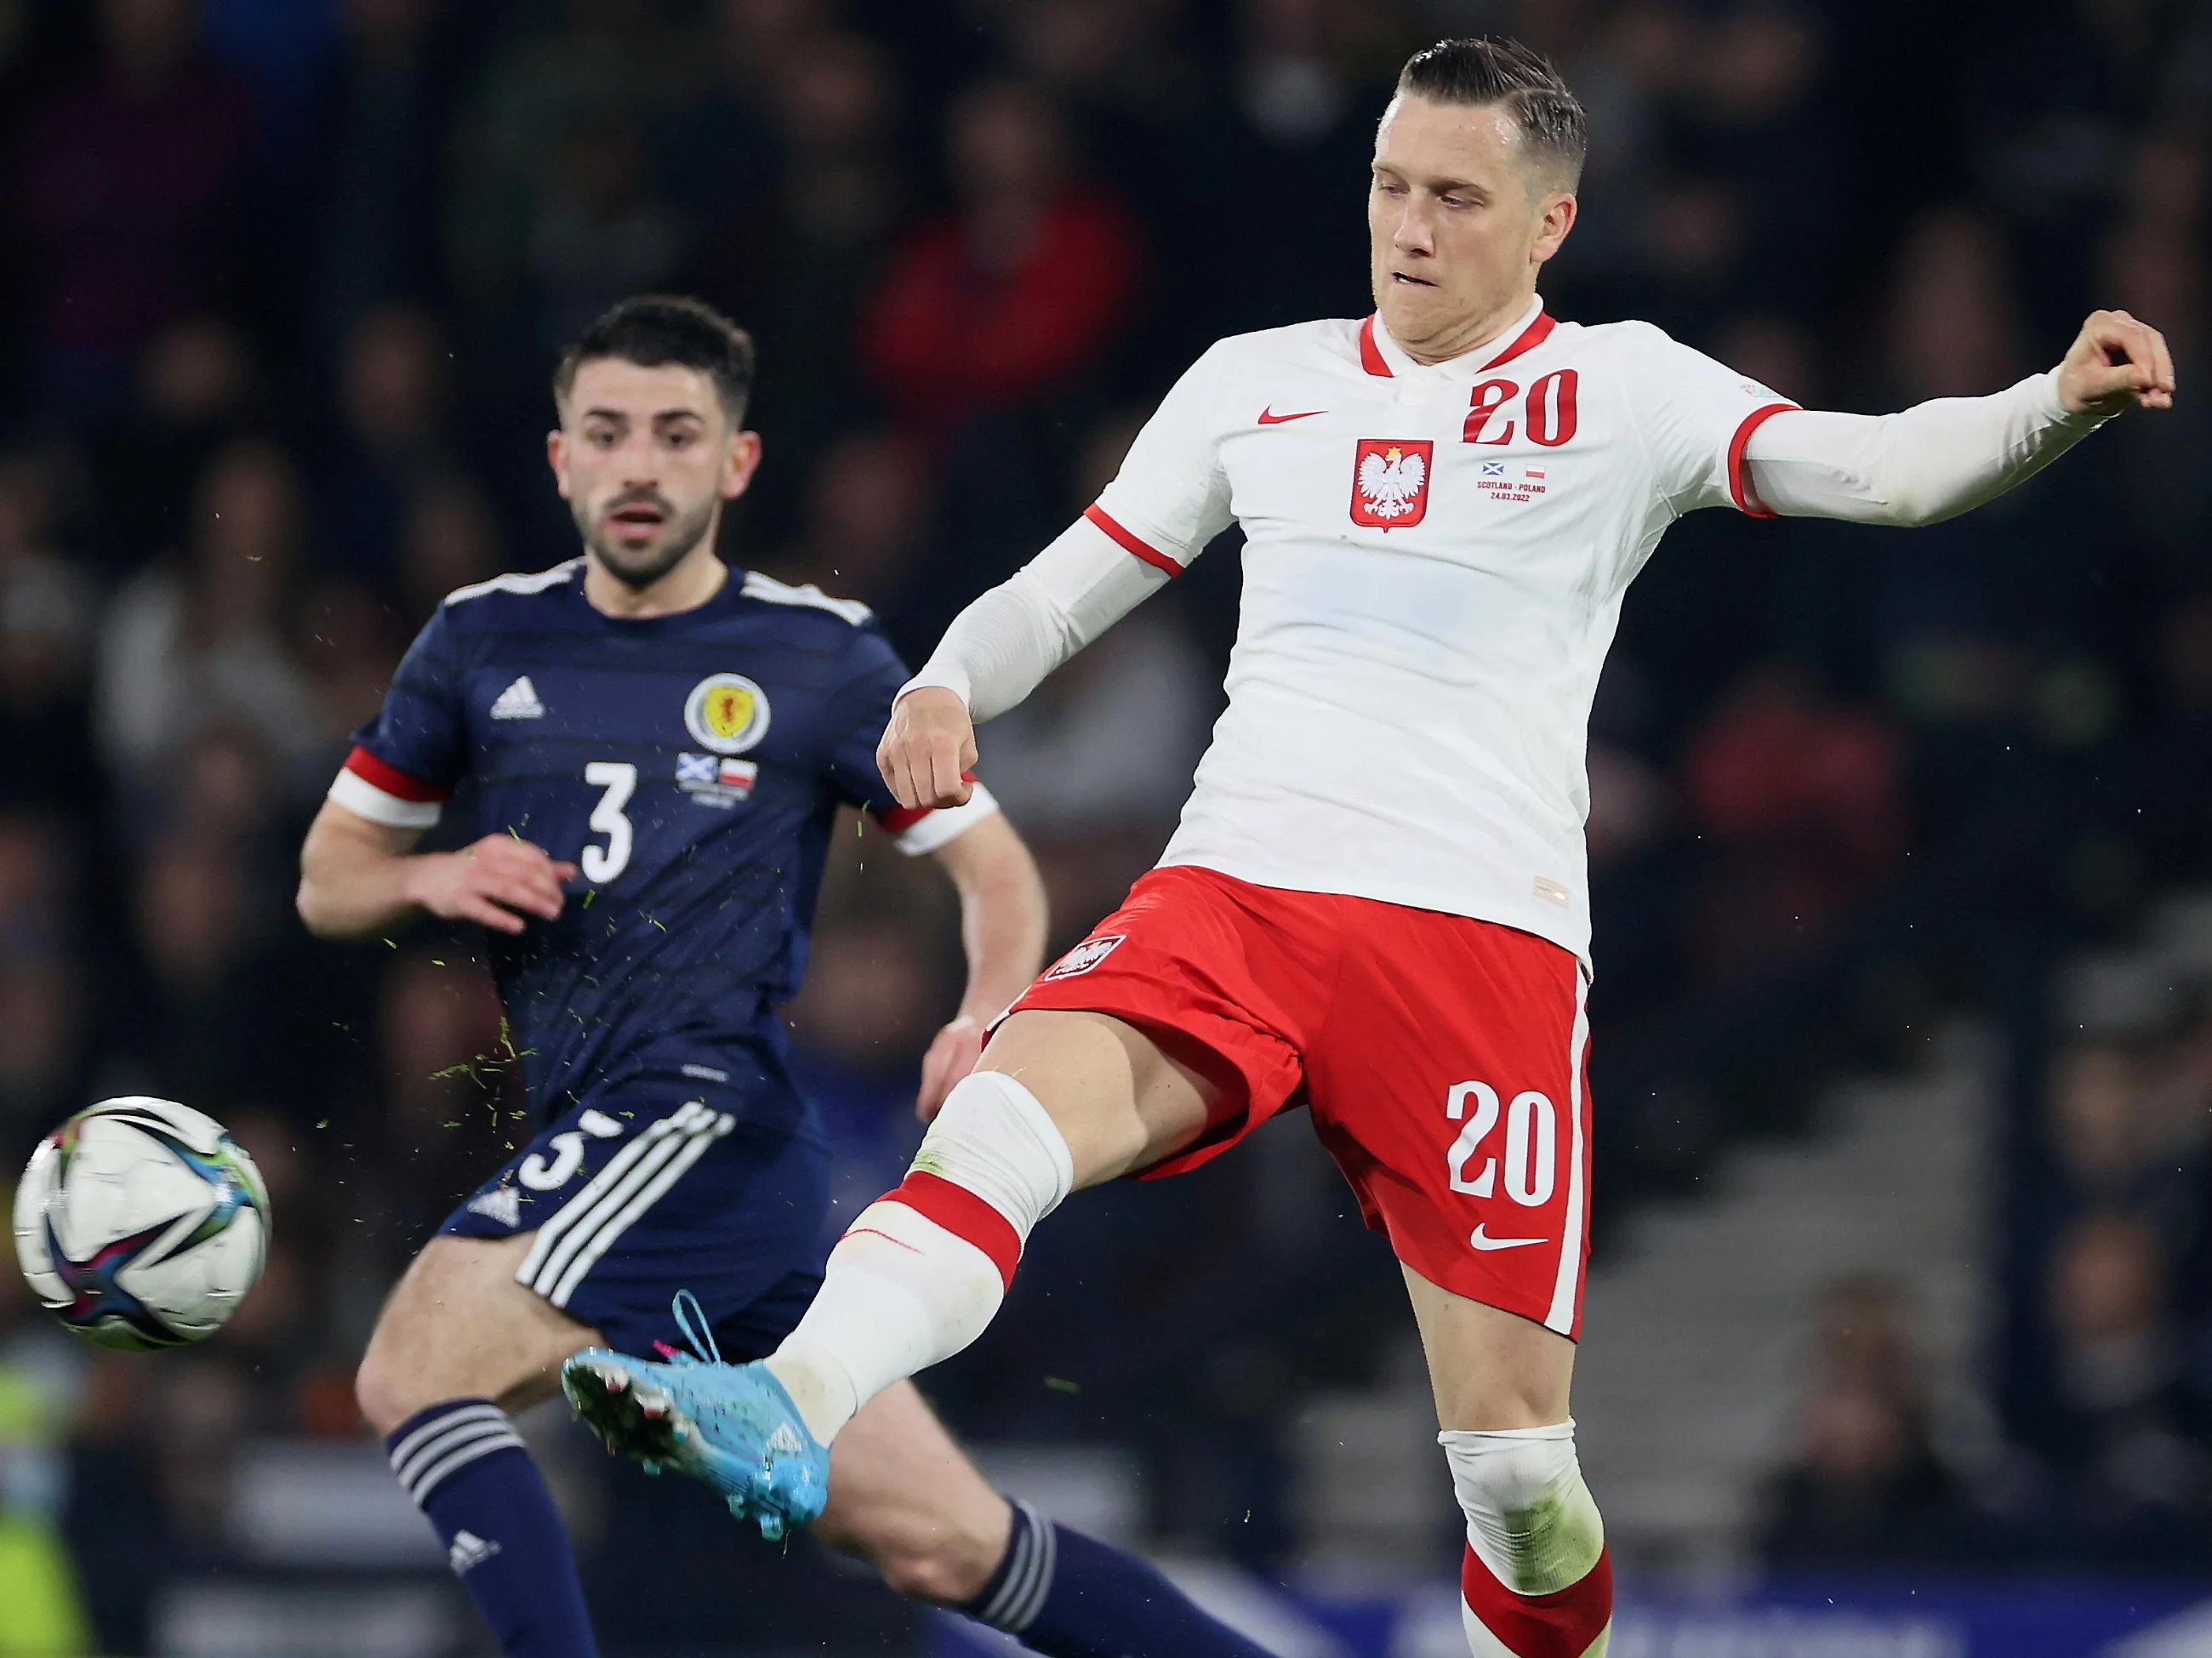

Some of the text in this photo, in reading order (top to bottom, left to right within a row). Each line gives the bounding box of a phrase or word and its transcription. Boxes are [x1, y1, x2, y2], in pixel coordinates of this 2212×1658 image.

[1461, 368, 1578, 447] 20
[1477, 481, 1512, 490] SCOTLAND
[1519, 483, 1546, 493] POLAND
[1491, 492, 1530, 502] 24.03.2022
[582, 762, 637, 884] 3
[1447, 1080, 1556, 1207] 20
